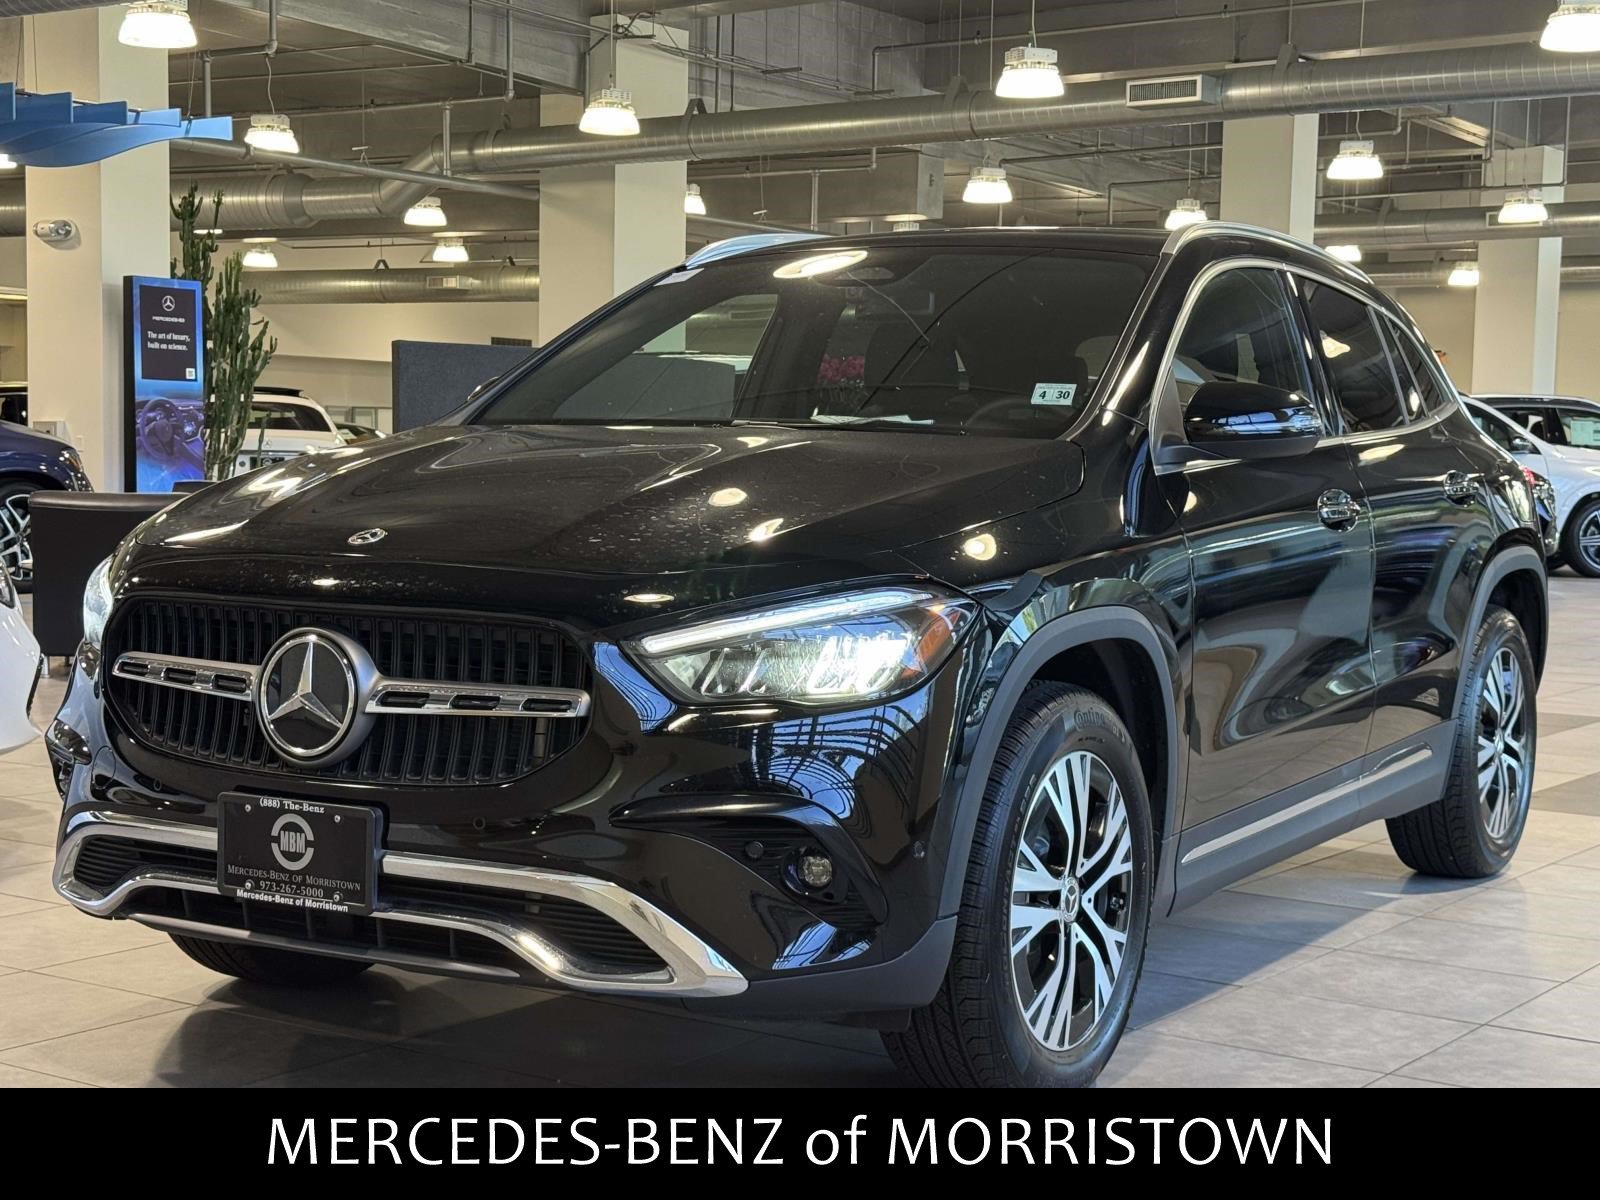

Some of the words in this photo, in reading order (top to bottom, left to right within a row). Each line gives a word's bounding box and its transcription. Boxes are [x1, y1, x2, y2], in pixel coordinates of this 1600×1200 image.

[148, 331, 157, 339] The
[1039, 390, 1047, 400] 4
[1055, 390, 1071, 400] 30
[260, 797, 280, 809] (888)
[283, 800, 325, 814] The-Benz
[280, 830, 306, 853] MBM
[260, 880, 324, 898] 973-267-5000
[305, 875, 361, 891] MORRISTOWN
[237, 889, 294, 906] Mercedes-Benz
[295, 896, 304, 906] of
[305, 900, 349, 913] Morristown
